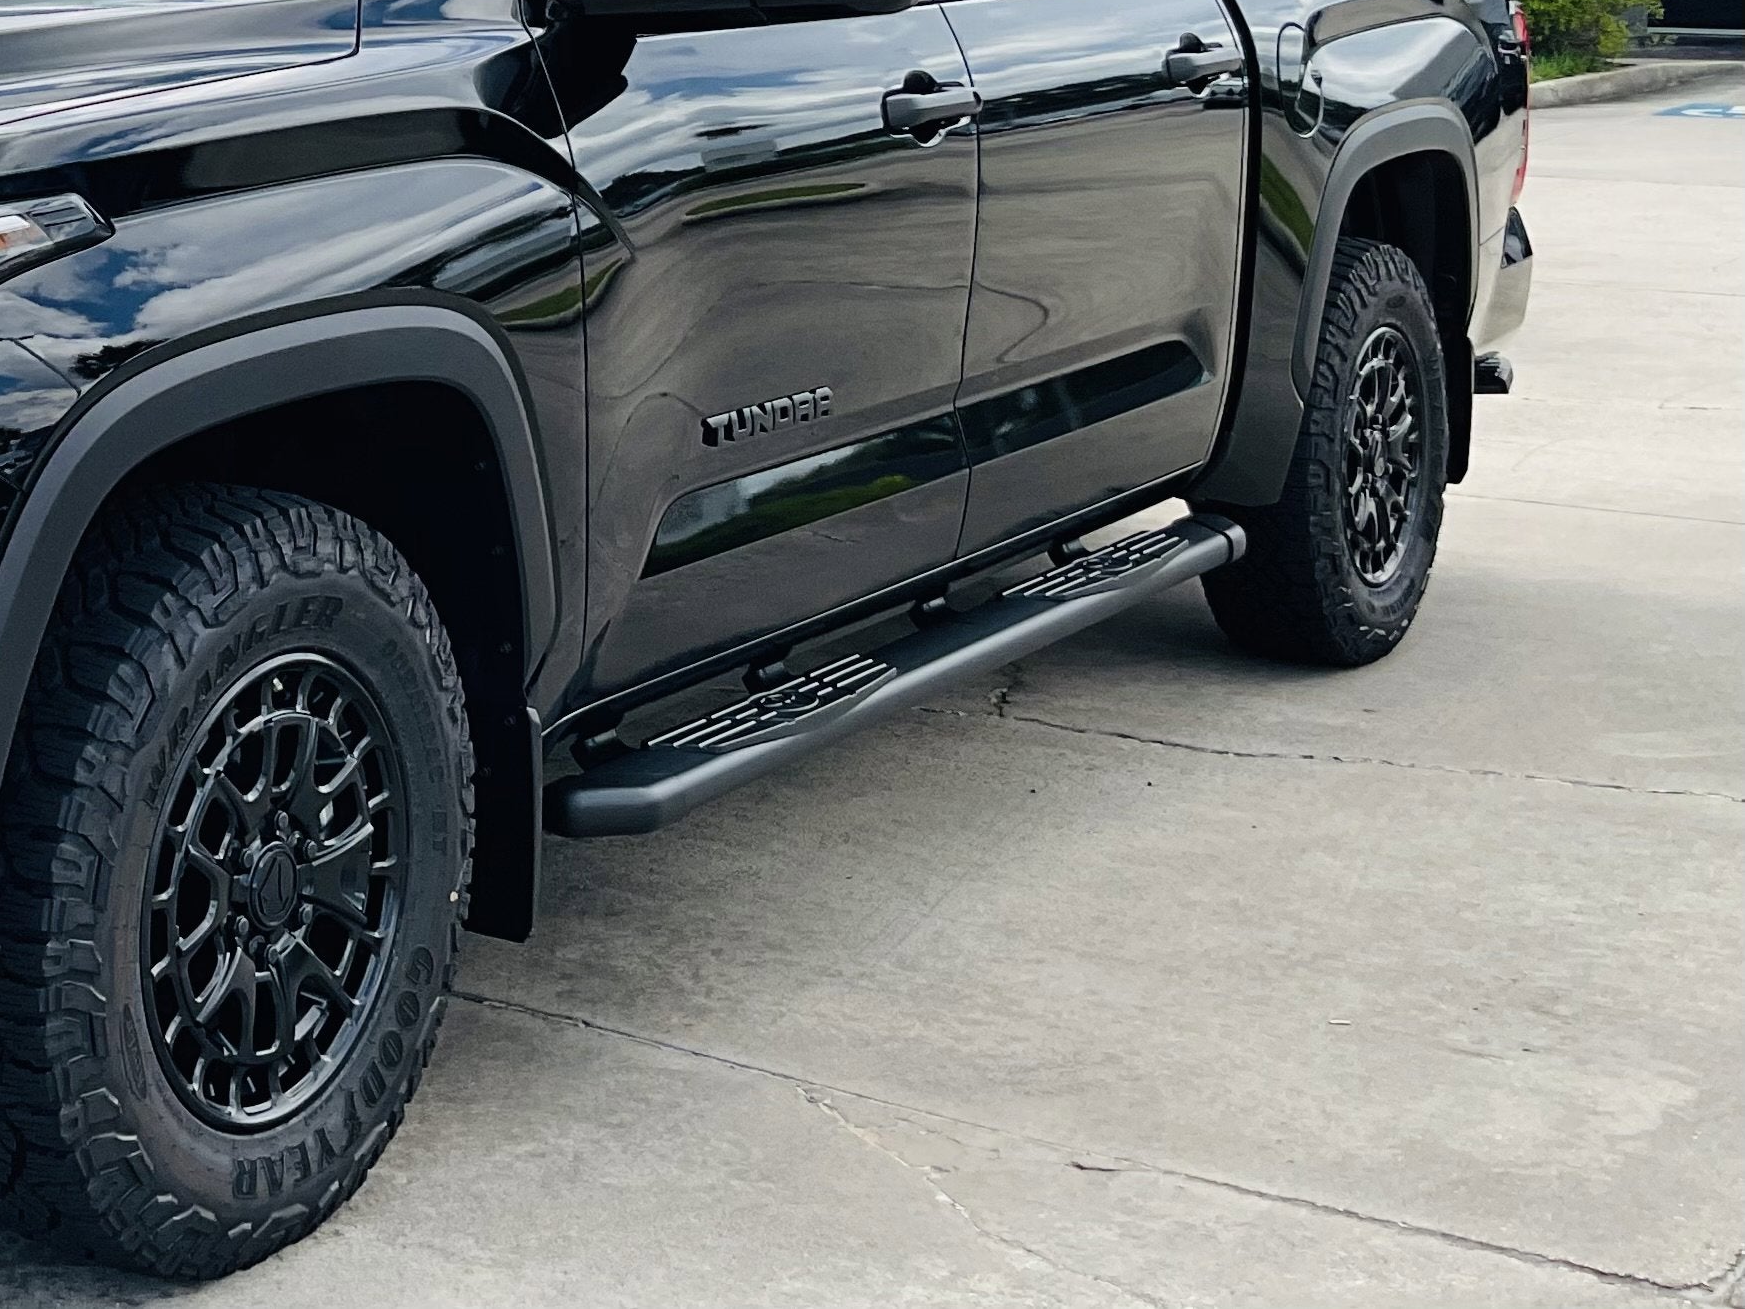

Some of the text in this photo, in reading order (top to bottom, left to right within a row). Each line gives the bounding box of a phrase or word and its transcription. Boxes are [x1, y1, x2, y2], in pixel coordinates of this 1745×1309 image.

[701, 386, 834, 448] TUNDRA
[139, 593, 345, 811] WRANGLER
[231, 944, 435, 1201] GOODYEAR
